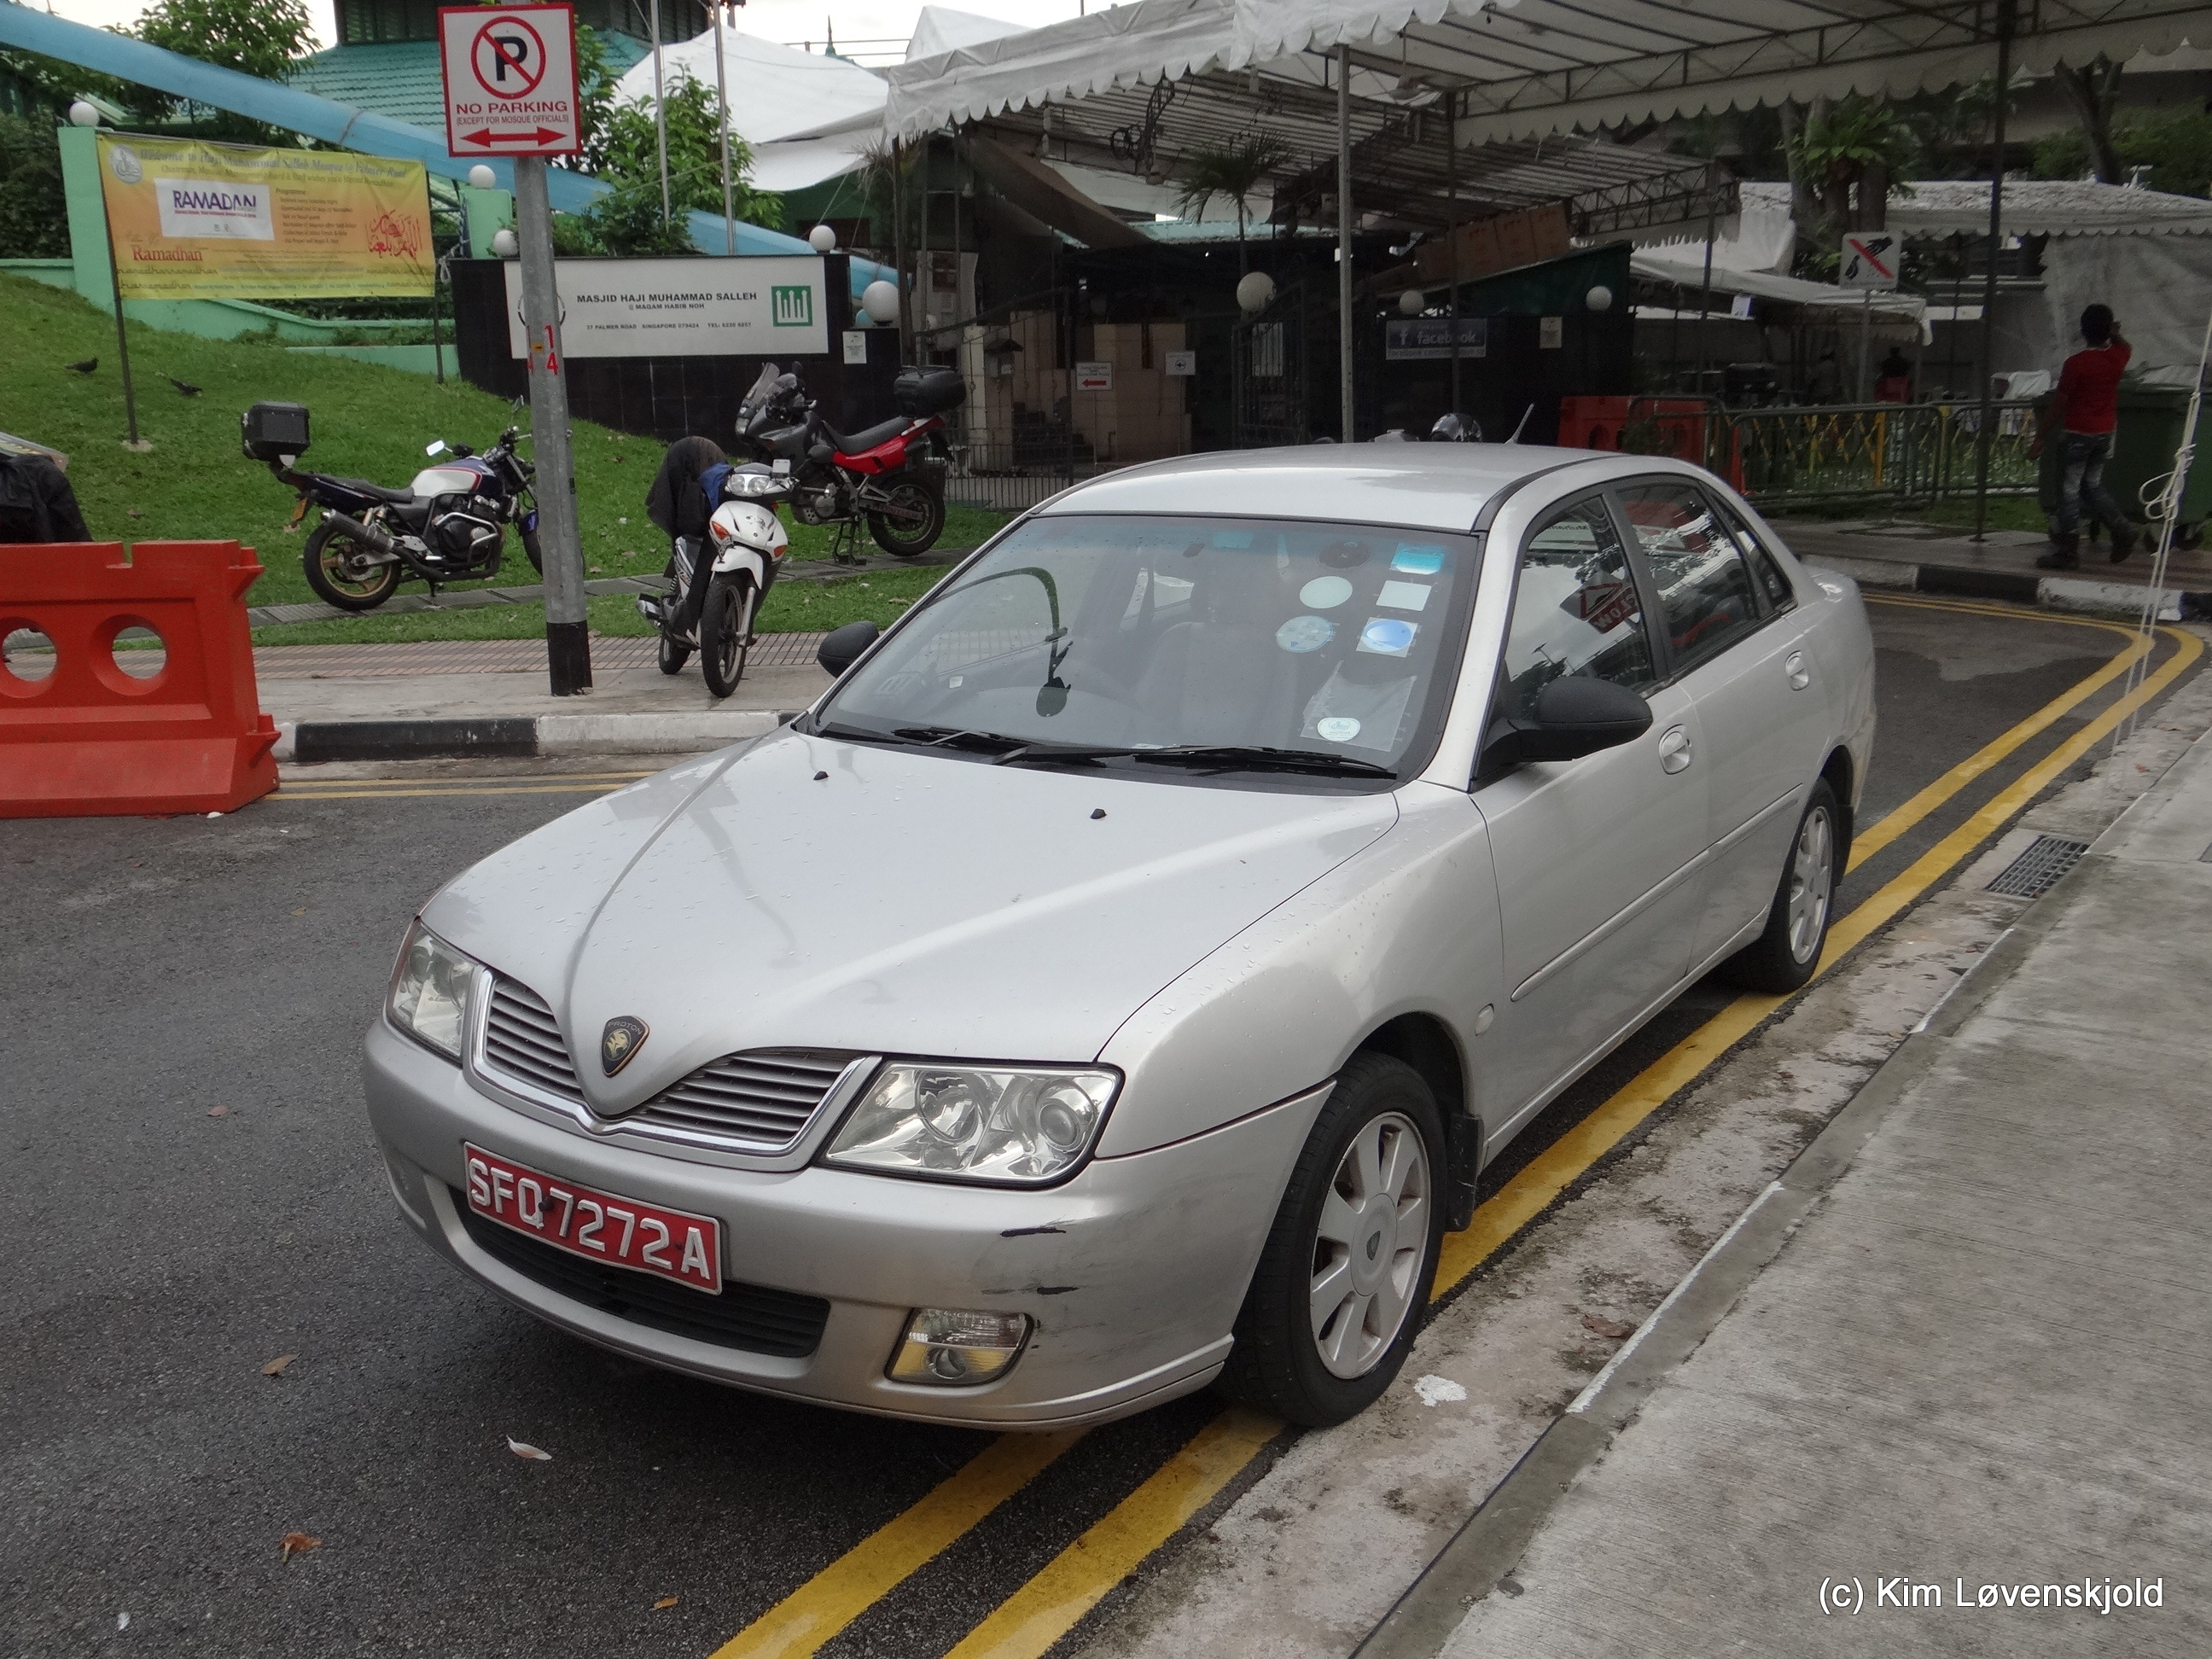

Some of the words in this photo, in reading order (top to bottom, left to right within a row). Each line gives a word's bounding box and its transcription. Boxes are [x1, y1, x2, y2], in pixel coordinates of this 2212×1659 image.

[494, 36, 527, 81] P
[457, 103, 482, 114] NO
[488, 101, 568, 114] PARKING
[457, 116, 484, 126] (EXCEPT
[502, 115, 531, 124] MOSQUE
[533, 114, 569, 124] OFFICIALS)
[172, 189, 256, 210] RAMADAN
[131, 244, 203, 261] Ramadhan
[577, 294, 617, 303] MASJID
[649, 294, 713, 302] MUHAMMAD
[1417, 329, 1476, 345] facebok
[608, 1021, 643, 1035] PROTON
[469, 1158, 710, 1280] SFQ7272A
